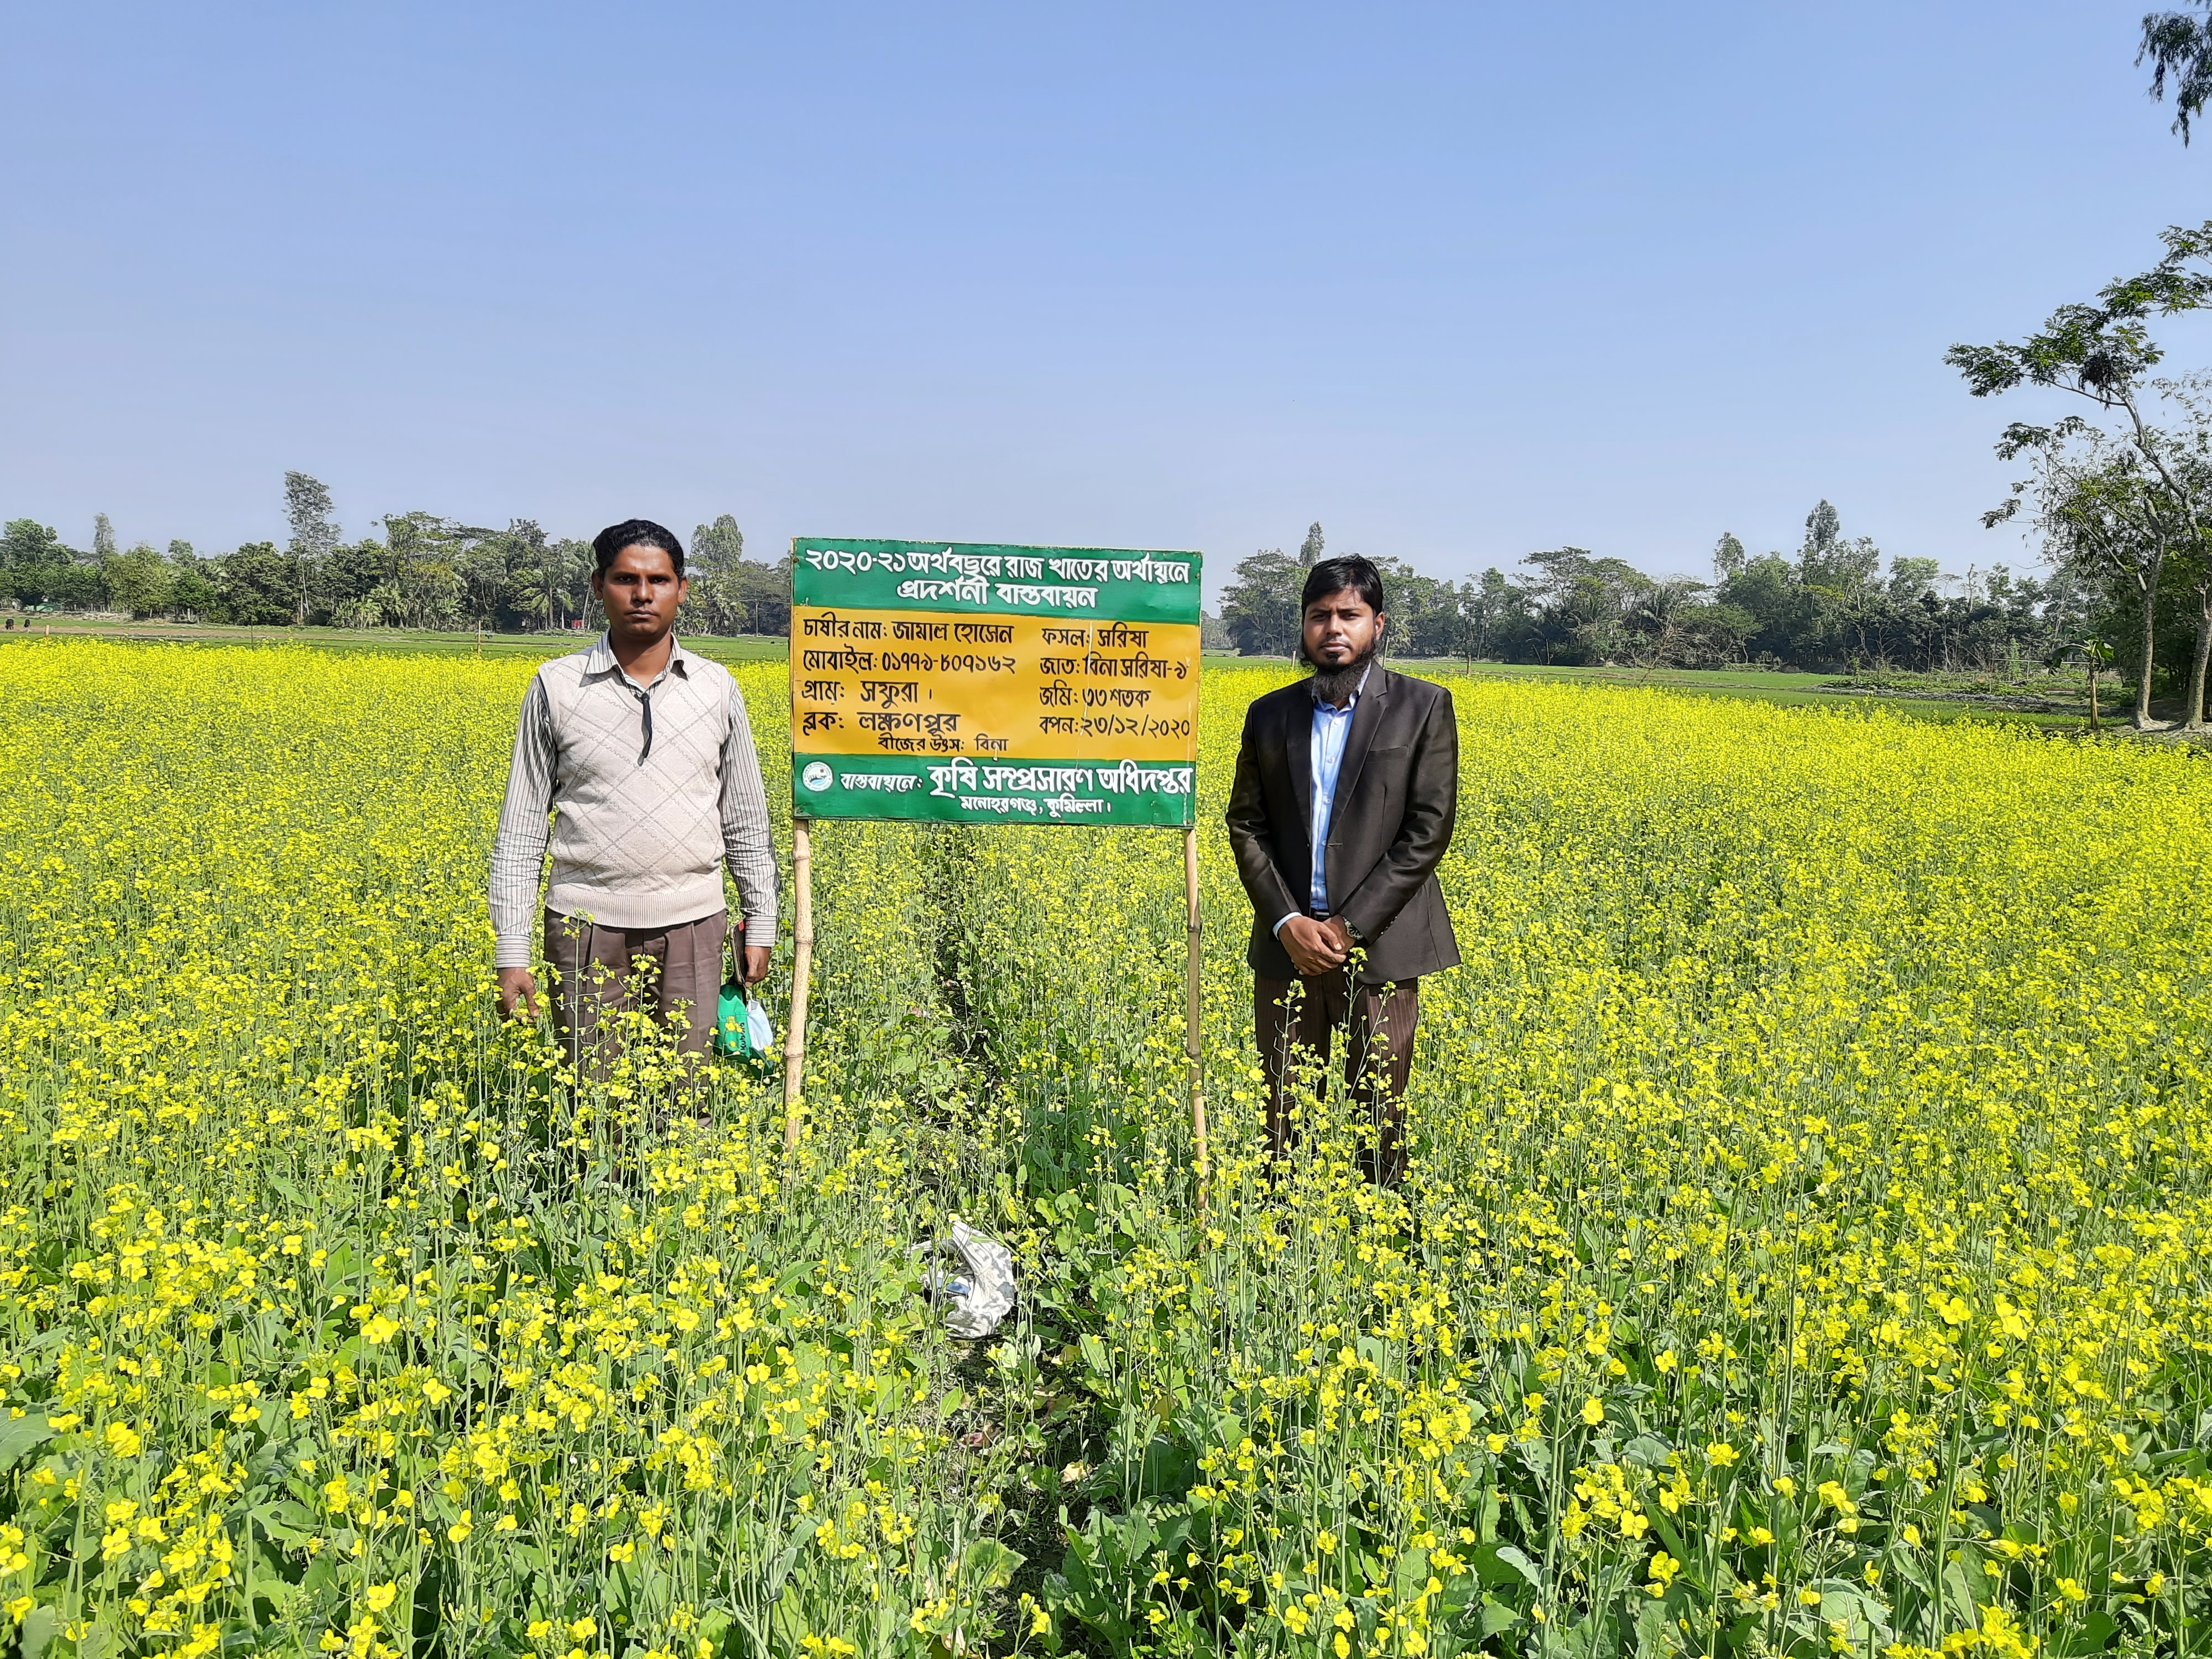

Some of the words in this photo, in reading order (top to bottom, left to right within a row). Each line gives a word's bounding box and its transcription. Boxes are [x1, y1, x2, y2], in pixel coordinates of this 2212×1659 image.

[1004, 556, 1045, 580] রাজ
[1049, 558, 1109, 582] খাতের
[1111, 552, 1190, 585] অর্থায়নে
[897, 576, 990, 604] প্রদর্শনী
[994, 583, 1099, 608] বাস্তবায়ন
[803, 612, 851, 638] চাষীর
[853, 621, 887, 640] নাম:
[891, 621, 950, 641] জামাল
[954, 623, 1015, 644] হোসেন
[1042, 628, 1090, 648] ফসল:
[1097, 622, 1149, 648] সরিষা
[804, 644, 877, 674] মোবাইল:
[1040, 658, 1080, 675] জাত:
[1082, 651, 1118, 677] বিনা
[860, 681, 919, 708] সফুরা
[1040, 680, 1078, 707] জমি:
[878, 733, 925, 752] বীজের
[974, 733, 1009, 752] বিনা
[839, 773, 924, 793] বাস্তবায়নে:
[926, 757, 979, 799] কৃষি
[982, 766, 1093, 793] সম্প্রসারণ
[1096, 759, 1193, 794] অধিদপ্তর
